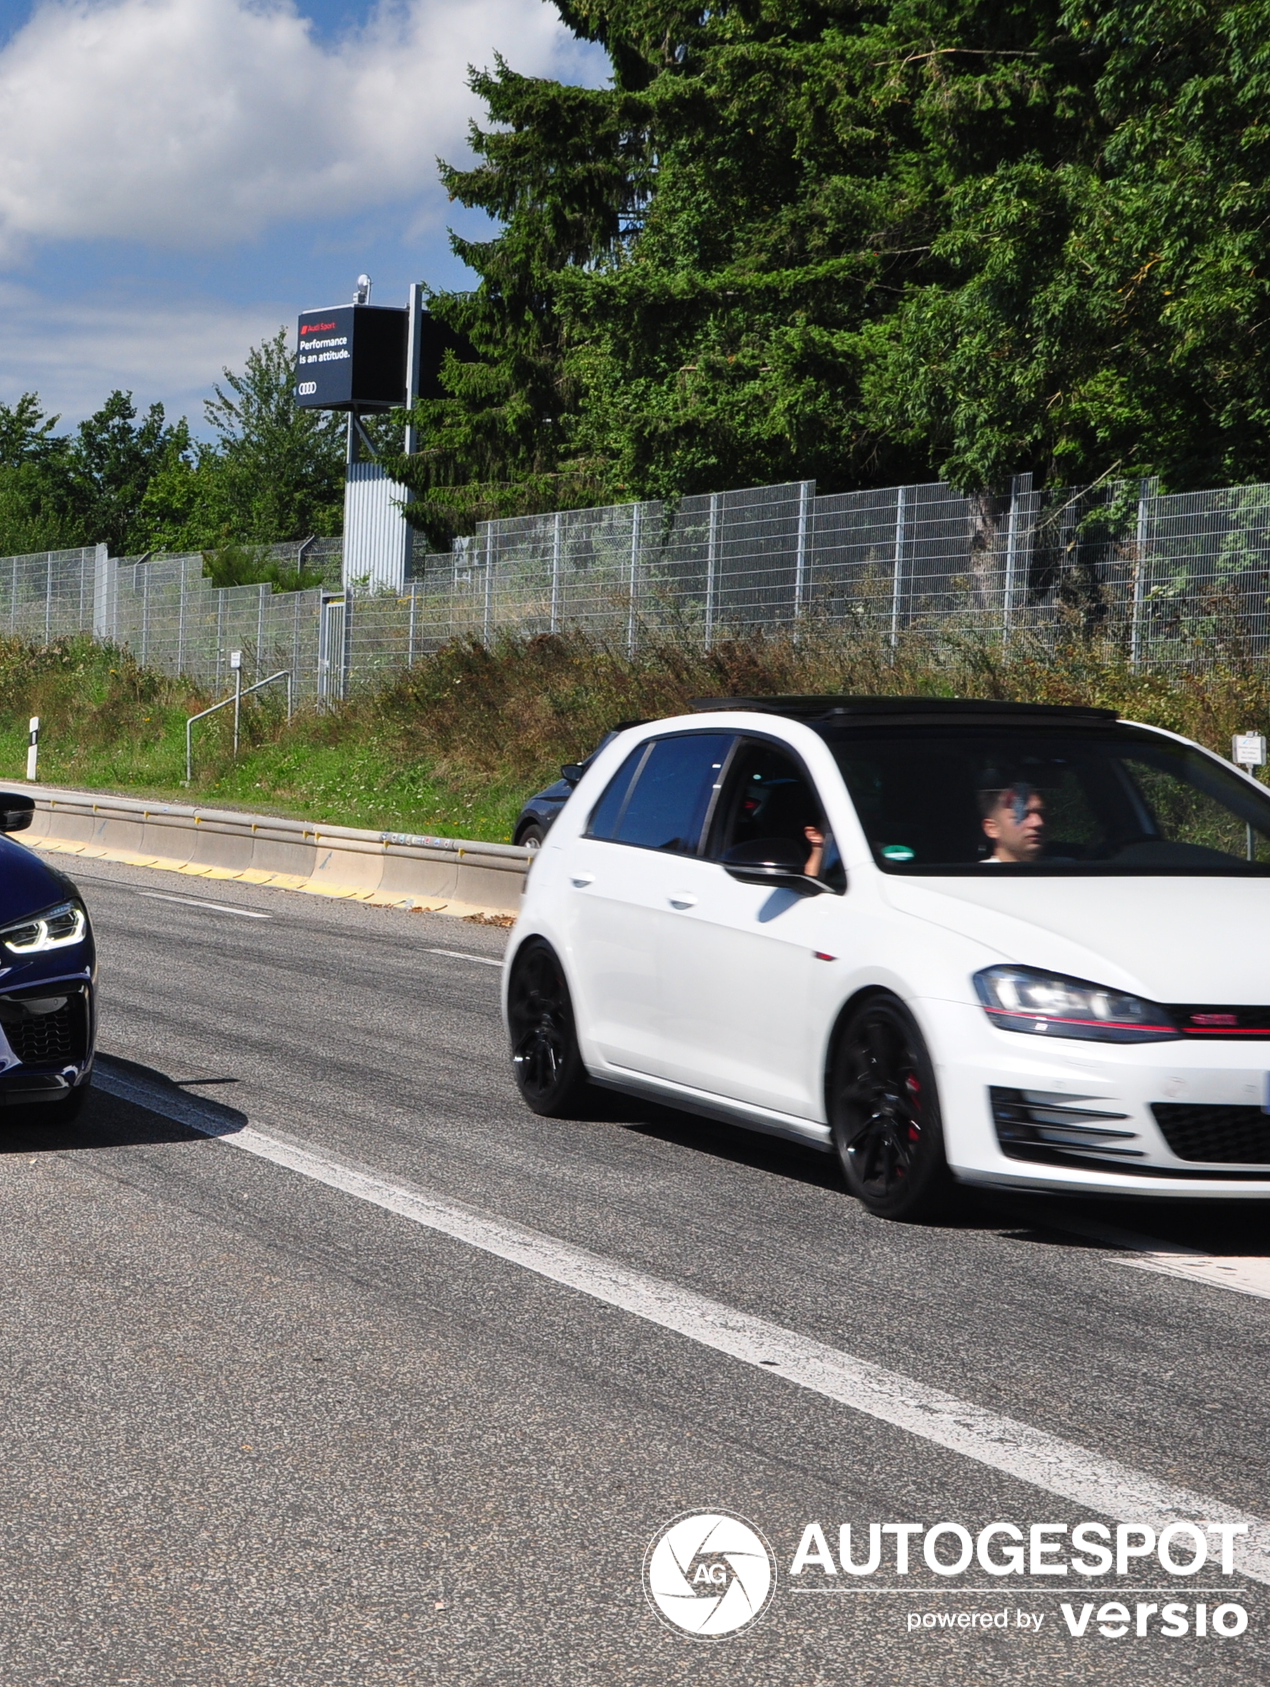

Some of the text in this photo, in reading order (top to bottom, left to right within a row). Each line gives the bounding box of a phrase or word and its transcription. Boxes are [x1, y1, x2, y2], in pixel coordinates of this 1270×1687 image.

[300, 337, 347, 351] Performance
[299, 349, 350, 364] is an attitude.
